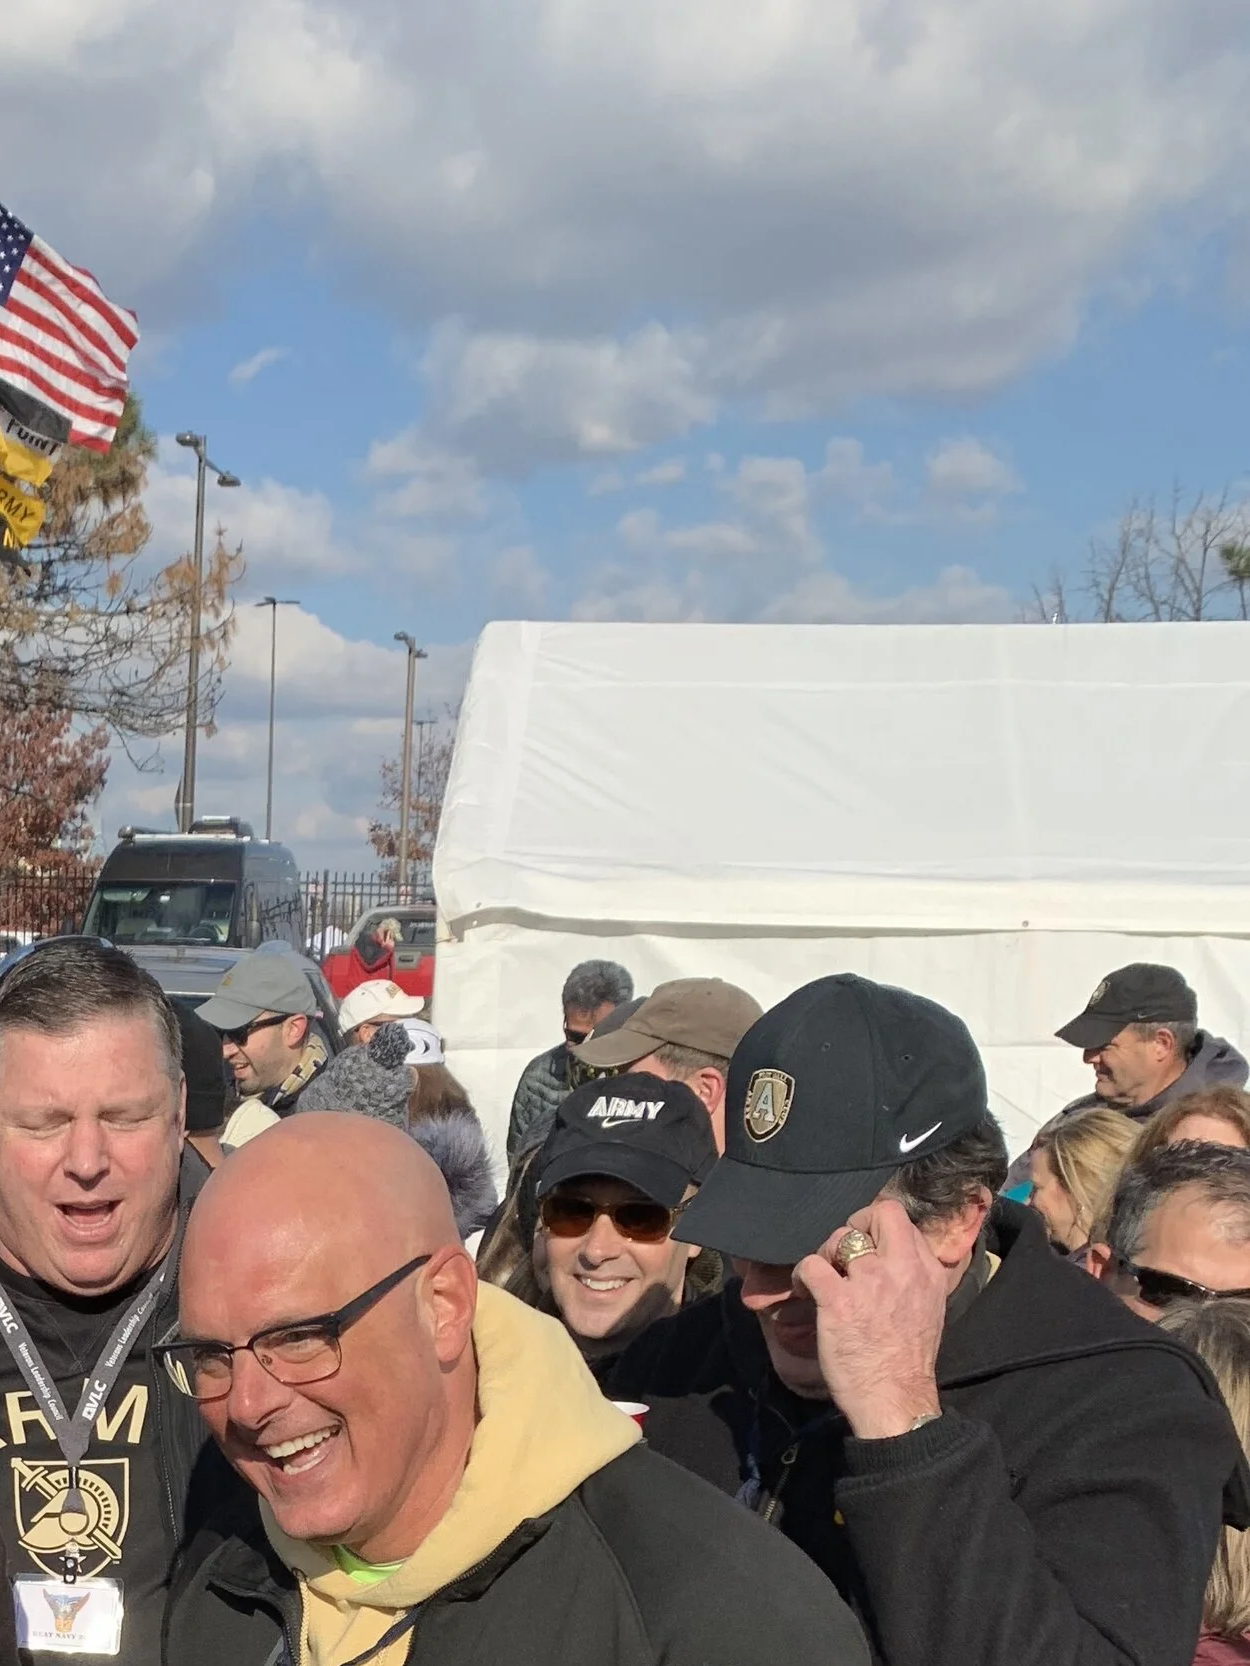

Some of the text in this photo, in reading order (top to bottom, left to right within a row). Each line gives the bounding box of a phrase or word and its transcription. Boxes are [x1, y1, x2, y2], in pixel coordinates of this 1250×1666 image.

[587, 1096, 666, 1120] ARMY
[18, 1341, 34, 1367] Veterans
[30, 1366, 53, 1399] Leadership
[47, 1398, 65, 1421] Council
[86, 1379, 107, 1412] VLC
[104, 1344, 124, 1368] Veterans
[117, 1313, 141, 1345] Leadership
